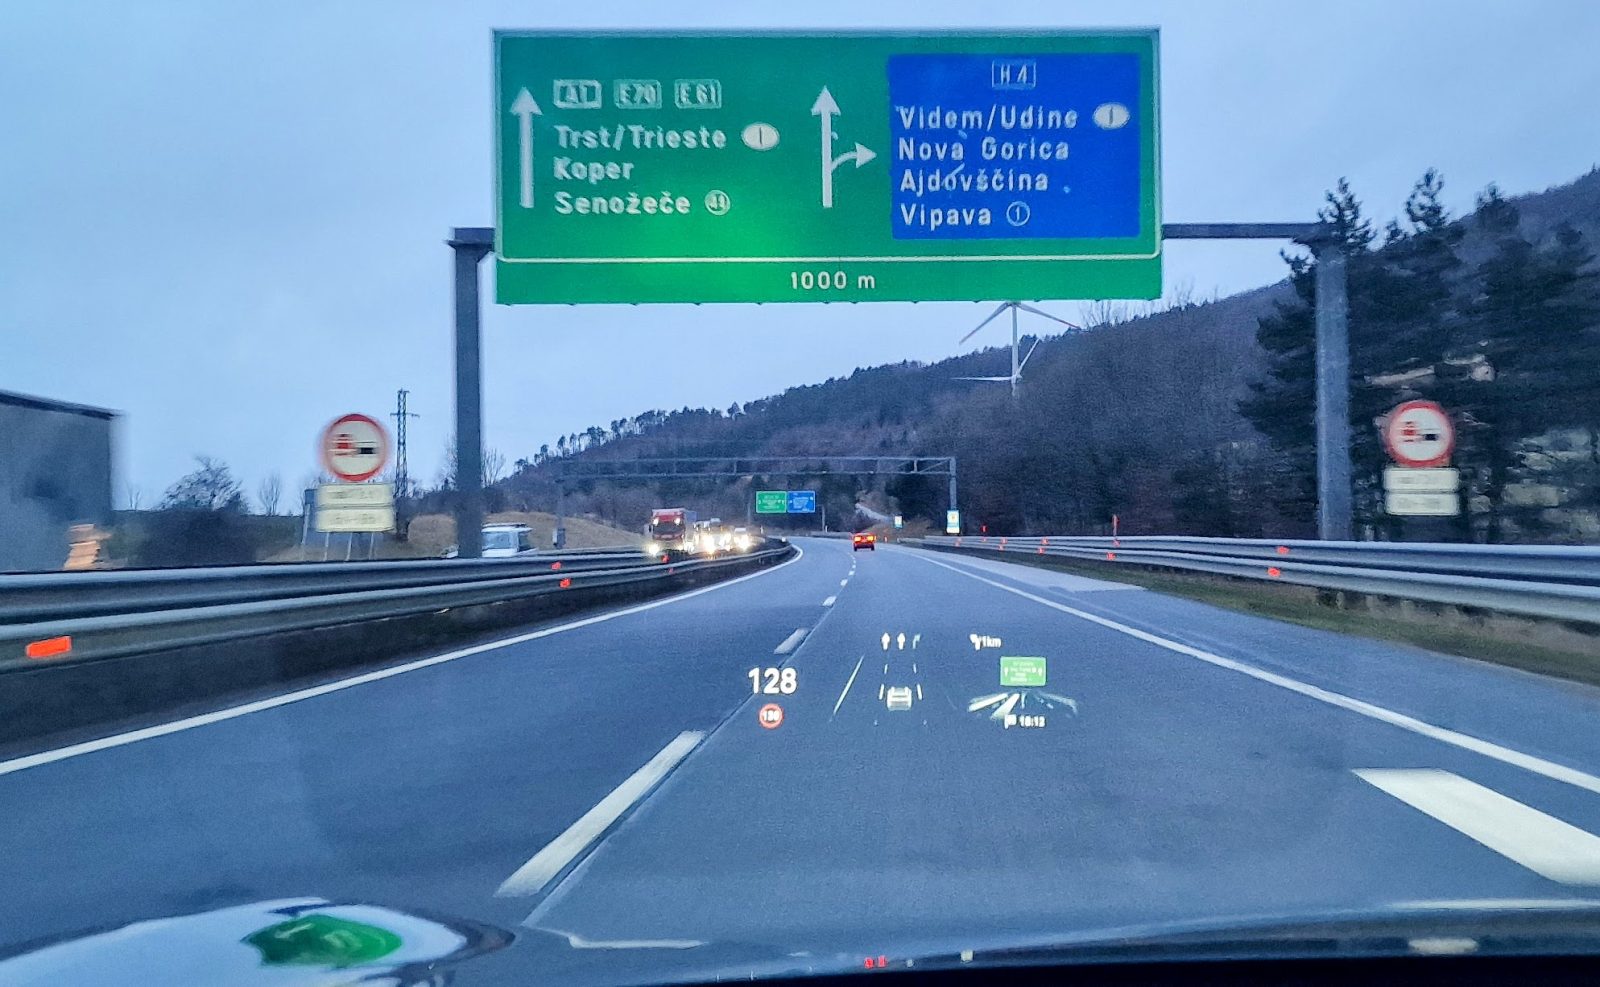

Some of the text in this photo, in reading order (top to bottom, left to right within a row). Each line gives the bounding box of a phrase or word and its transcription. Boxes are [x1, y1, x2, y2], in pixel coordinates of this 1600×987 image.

[898, 103, 1078, 131] Videm/Udine
[554, 124, 727, 151] Trst/Trieste
[899, 136, 1069, 161] Nova Gorica
[553, 156, 635, 184] Koper
[900, 167, 1049, 197] Ajdovščina
[554, 190, 691, 215] Senožeče
[900, 202, 992, 231] Vipava
[791, 271, 875, 290] 1000 m
[748, 667, 797, 694] 128
